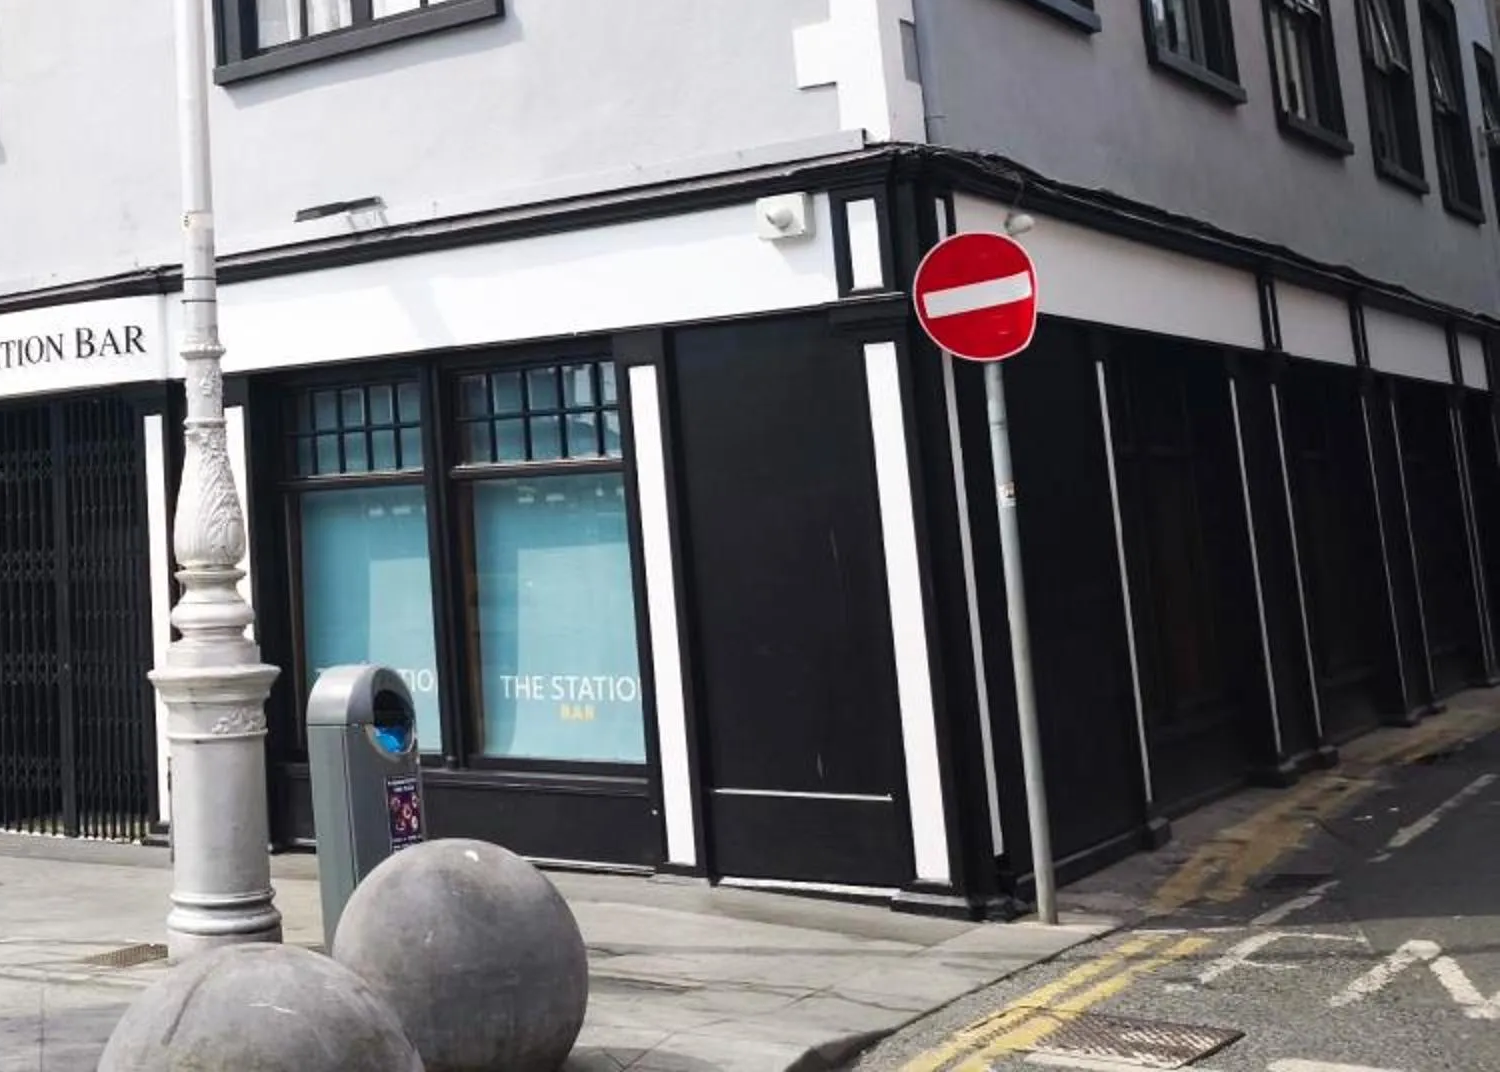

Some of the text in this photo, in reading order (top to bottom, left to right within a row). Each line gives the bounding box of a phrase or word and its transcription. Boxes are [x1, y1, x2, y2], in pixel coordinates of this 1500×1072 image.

[75, 324, 147, 360] BAR
[500, 675, 545, 700] THE
[560, 703, 595, 721] BAR
